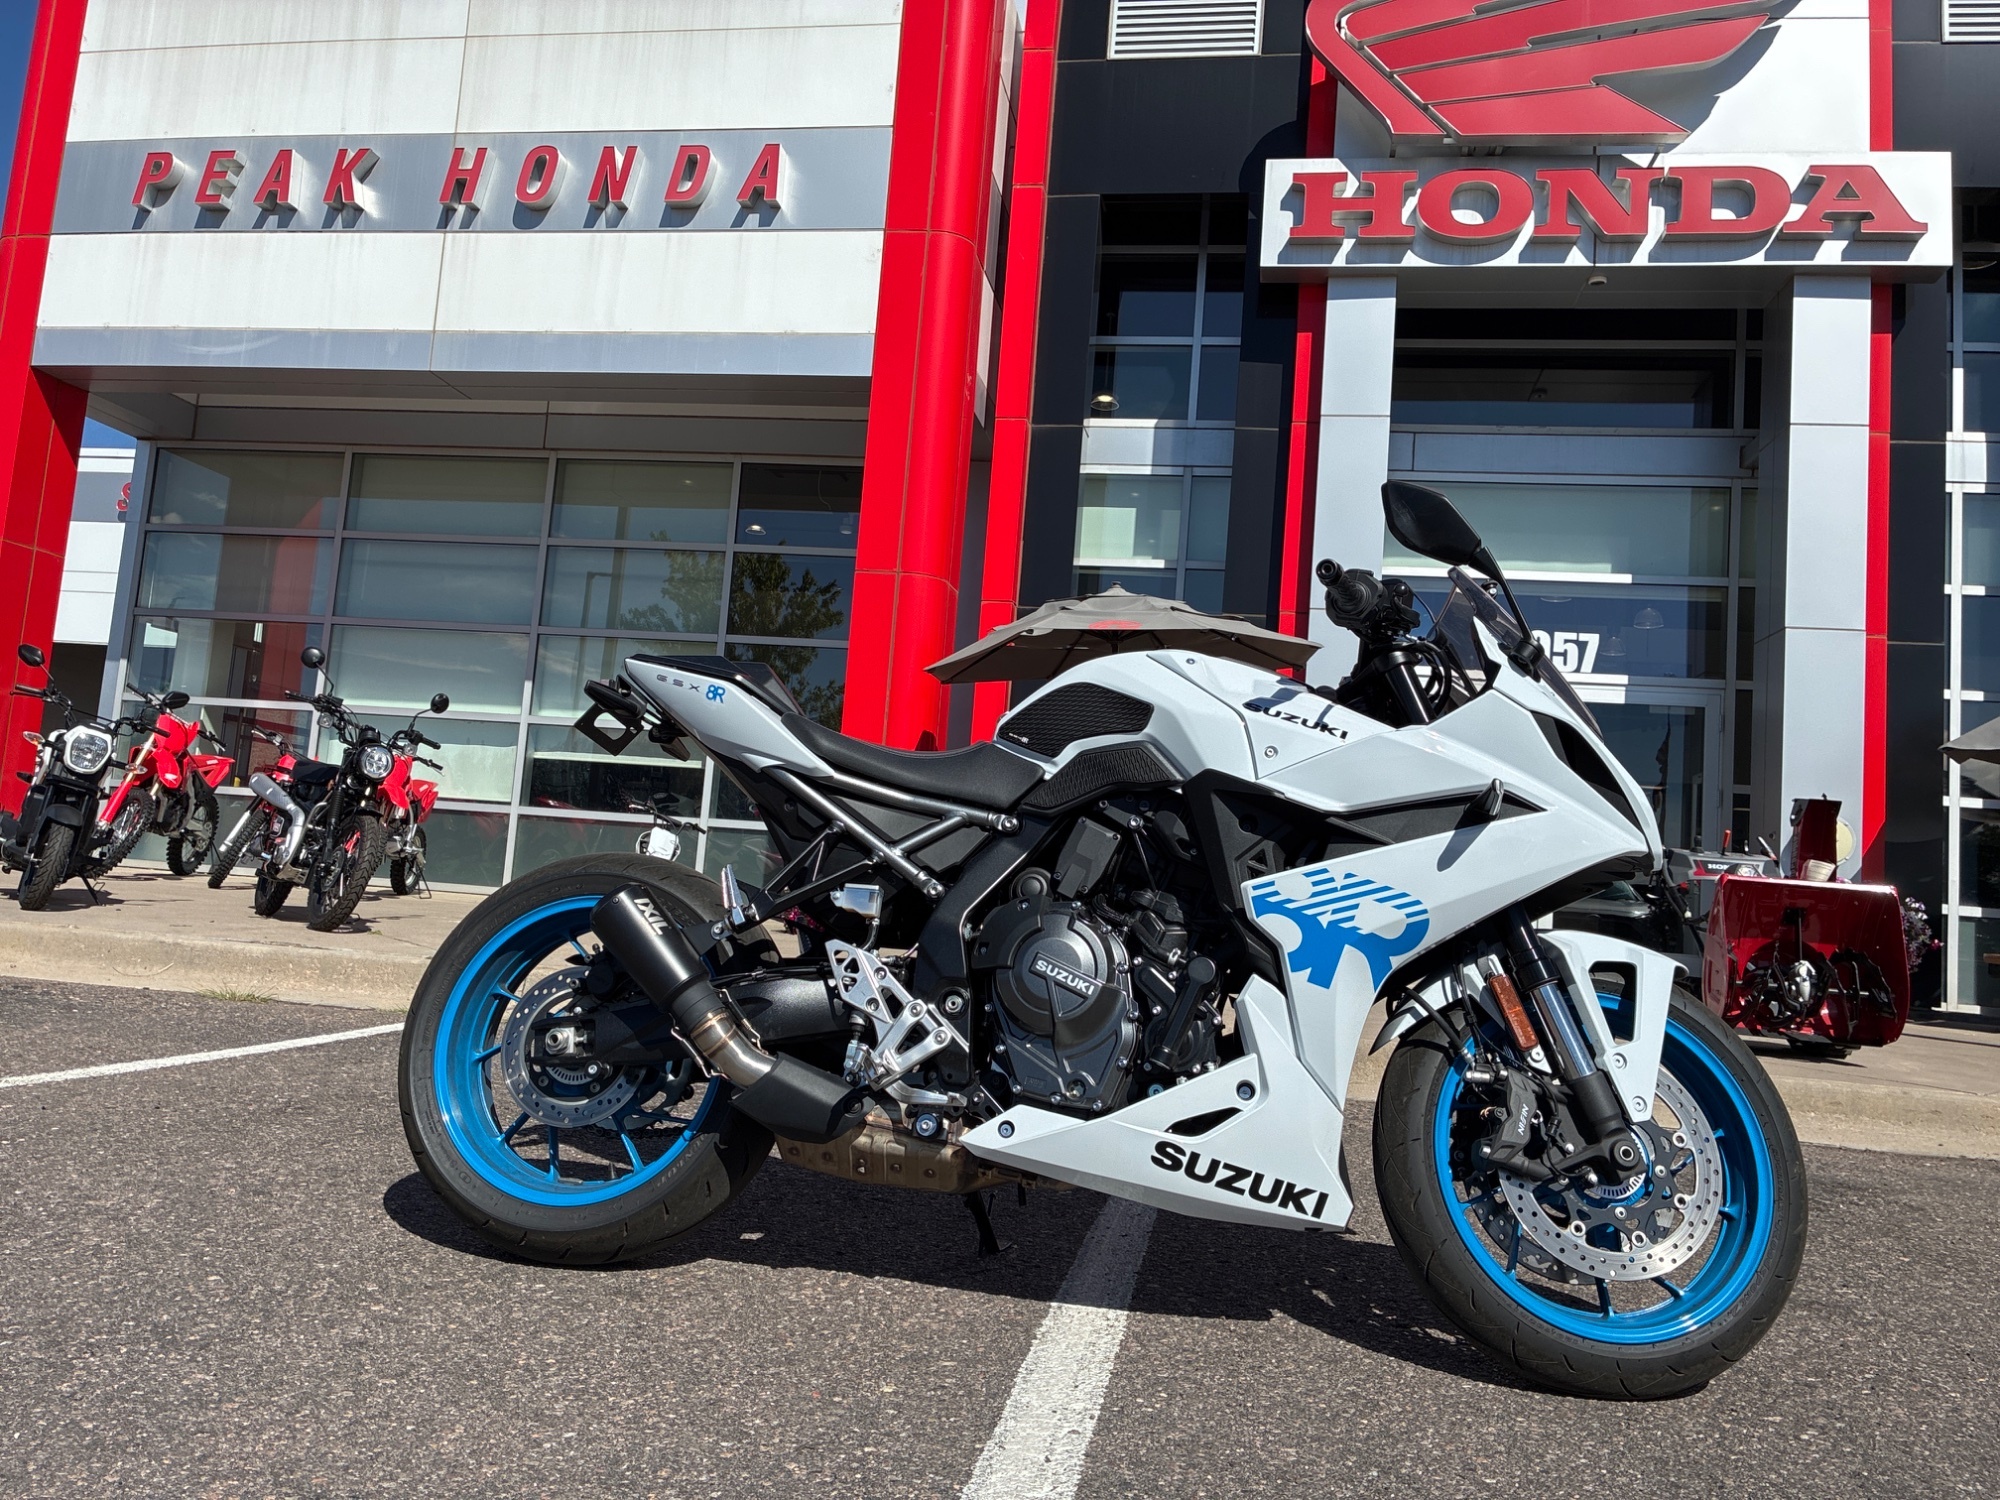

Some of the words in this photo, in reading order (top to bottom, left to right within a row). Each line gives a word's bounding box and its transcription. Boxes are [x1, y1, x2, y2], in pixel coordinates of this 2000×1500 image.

[131, 147, 376, 208] PEAK
[439, 143, 782, 208] HONDA
[1289, 165, 1928, 243] HONDA
[706, 684, 726, 703] 8R
[1242, 702, 1348, 740] SUZUKI
[633, 898, 669, 935] IXIL
[1035, 959, 1095, 995] SUZUKI
[1150, 1140, 1330, 1220] SUZUKI
